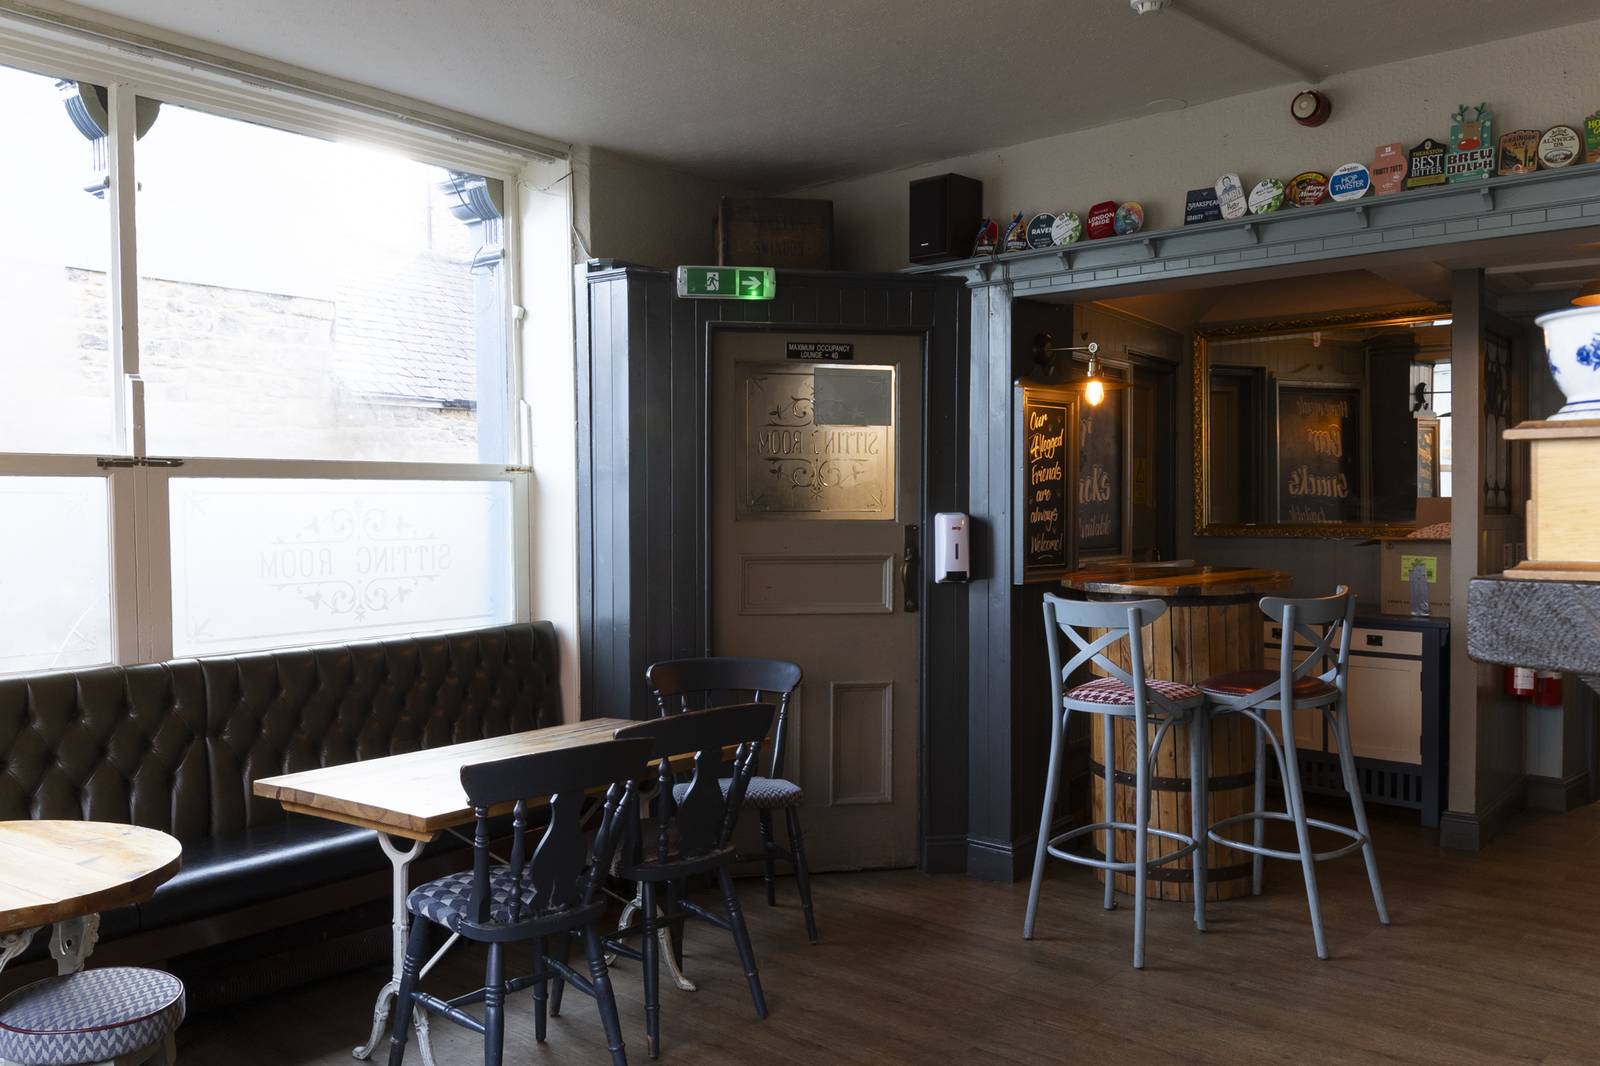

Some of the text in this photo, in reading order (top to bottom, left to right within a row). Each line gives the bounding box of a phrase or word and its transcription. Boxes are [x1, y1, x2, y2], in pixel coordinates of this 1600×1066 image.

[1542, 135, 1576, 144] ALNWICK
[1412, 154, 1443, 170] BEST
[1447, 148, 1492, 165] BREW
[1411, 166, 1442, 176] BITTER
[1447, 160, 1492, 174] DOLPH
[1336, 180, 1364, 191] TWISTER
[1341, 174, 1358, 184] HOP
[1187, 200, 1217, 211] BRAKSPEA
[1088, 212, 1115, 224] LONDON
[1091, 218, 1110, 228] PRIDE
[788, 343, 850, 352] MAXIMUM OCCUPANCY
[1030, 411, 1048, 431] Our
[1031, 462, 1062, 486] Friends
[1036, 488, 1052, 502] are
[1030, 506, 1058, 532] always
[1031, 532, 1063, 556] Welcome!
